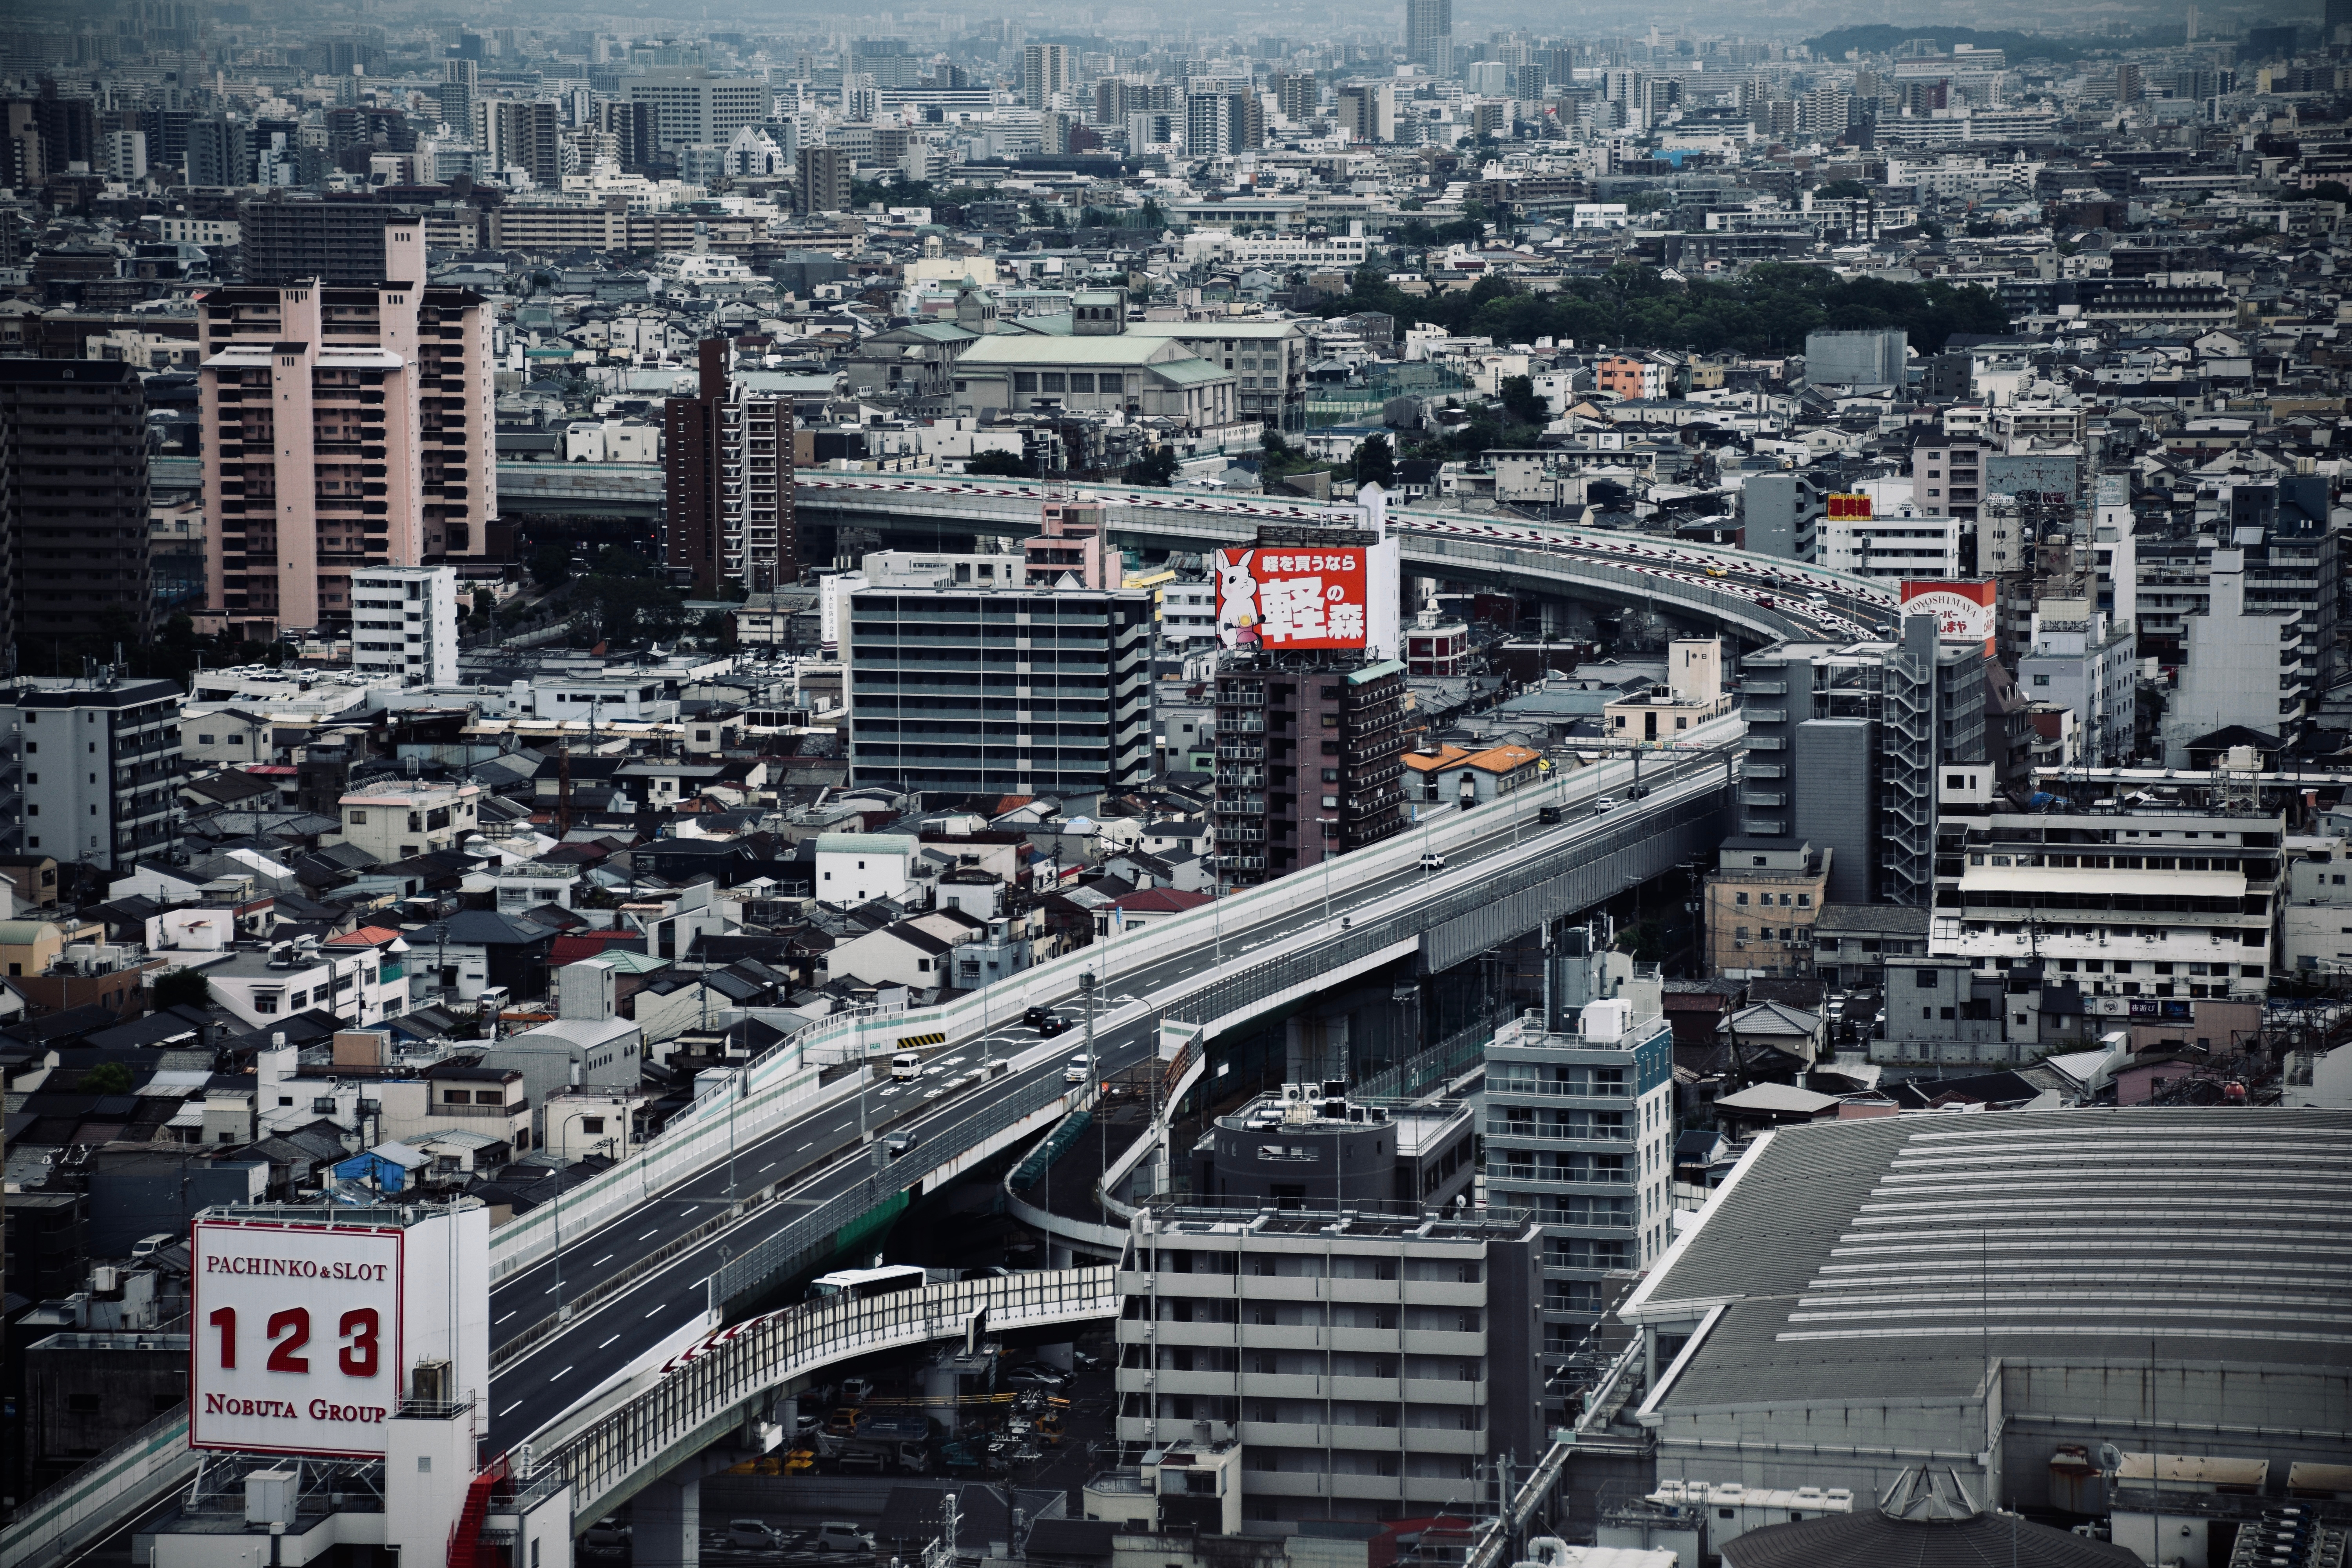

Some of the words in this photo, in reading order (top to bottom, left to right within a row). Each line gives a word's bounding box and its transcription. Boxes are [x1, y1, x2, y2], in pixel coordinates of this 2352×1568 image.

[1262, 555, 1356, 572] 軽を買うなら
[1259, 576, 1364, 642] 軽の森
[1907, 596, 1977, 617] TOYOSHIMAYA
[1940, 621, 1967, 633] しまや
[206, 1256, 387, 1281] PACHINKO&SLOT
